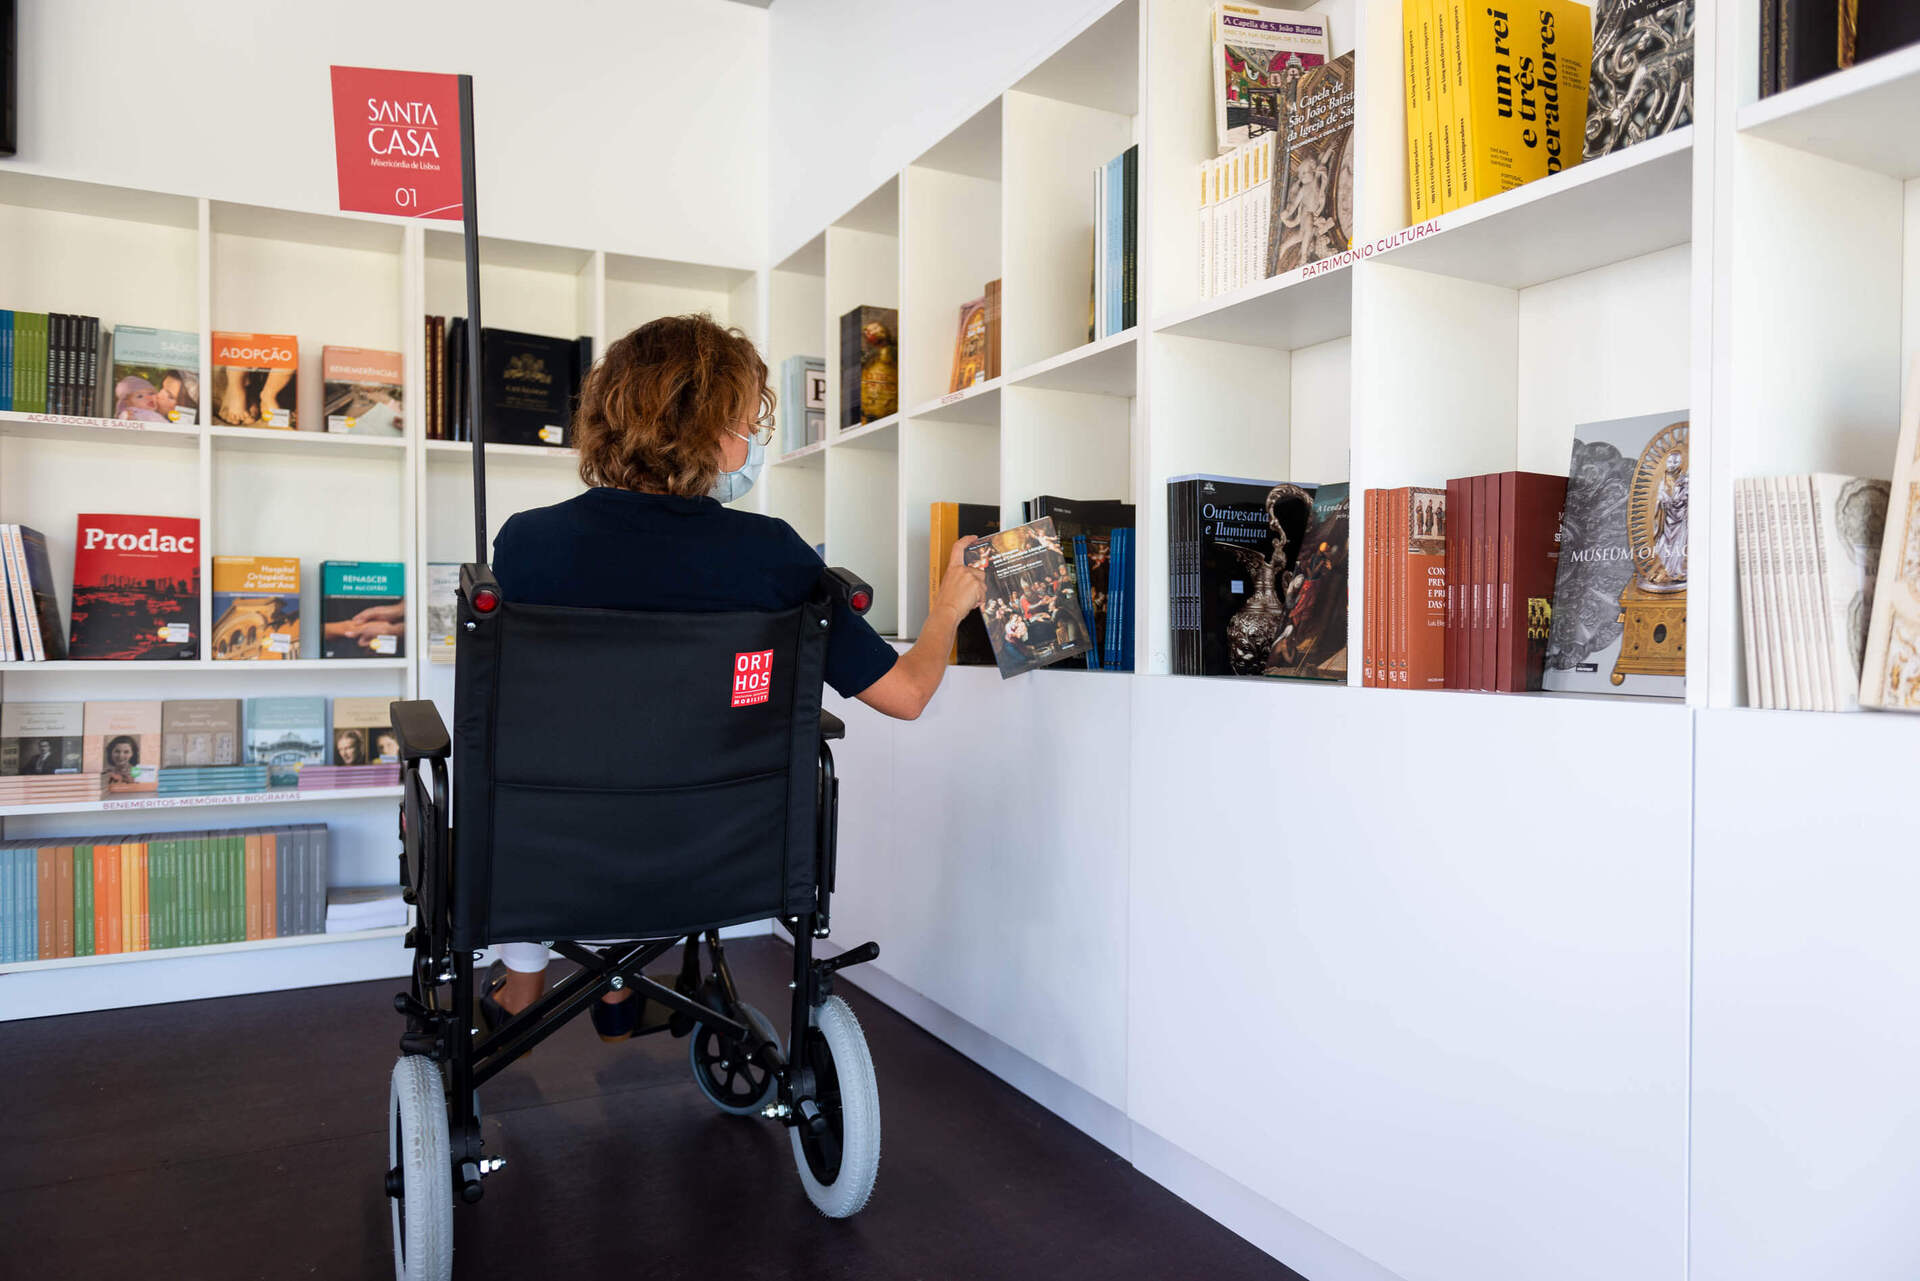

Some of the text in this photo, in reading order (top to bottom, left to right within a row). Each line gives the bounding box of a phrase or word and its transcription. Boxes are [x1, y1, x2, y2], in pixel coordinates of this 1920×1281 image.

[1487, 8, 1512, 119] um rei
[1299, 87, 1330, 109] Capela
[1331, 81, 1344, 94] de
[1514, 56, 1537, 148] e três
[1537, 10, 1562, 176] peradores
[368, 98, 438, 126] SANTA
[1289, 90, 1355, 129] São João Batist
[1287, 129, 1298, 142] da
[1299, 119, 1325, 138] Igreja
[1326, 112, 1338, 125] de
[368, 127, 440, 158] CASA
[371, 158, 440, 171] Misericórdia de Lisboa
[395, 187, 417, 207] 01
[1376, 220, 1441, 252] CULTURAL
[219, 346, 293, 363] ADOPÇÃO
[62, 416, 99, 426] SOCIAL
[1203, 503, 1270, 522] Ourivesaria
[1205, 521, 1267, 539] e Iluminura
[84, 528, 195, 553] Prodac
[1570, 546, 1634, 562] MUSEUM
[1639, 546, 1657, 559] OF
[1427, 567, 1445, 576] CON
[1428, 589, 1432, 597] E
[737, 652, 772, 672] ORT
[735, 671, 770, 691] HOS
[244, 793, 302, 803] BIOGRAFIAS
